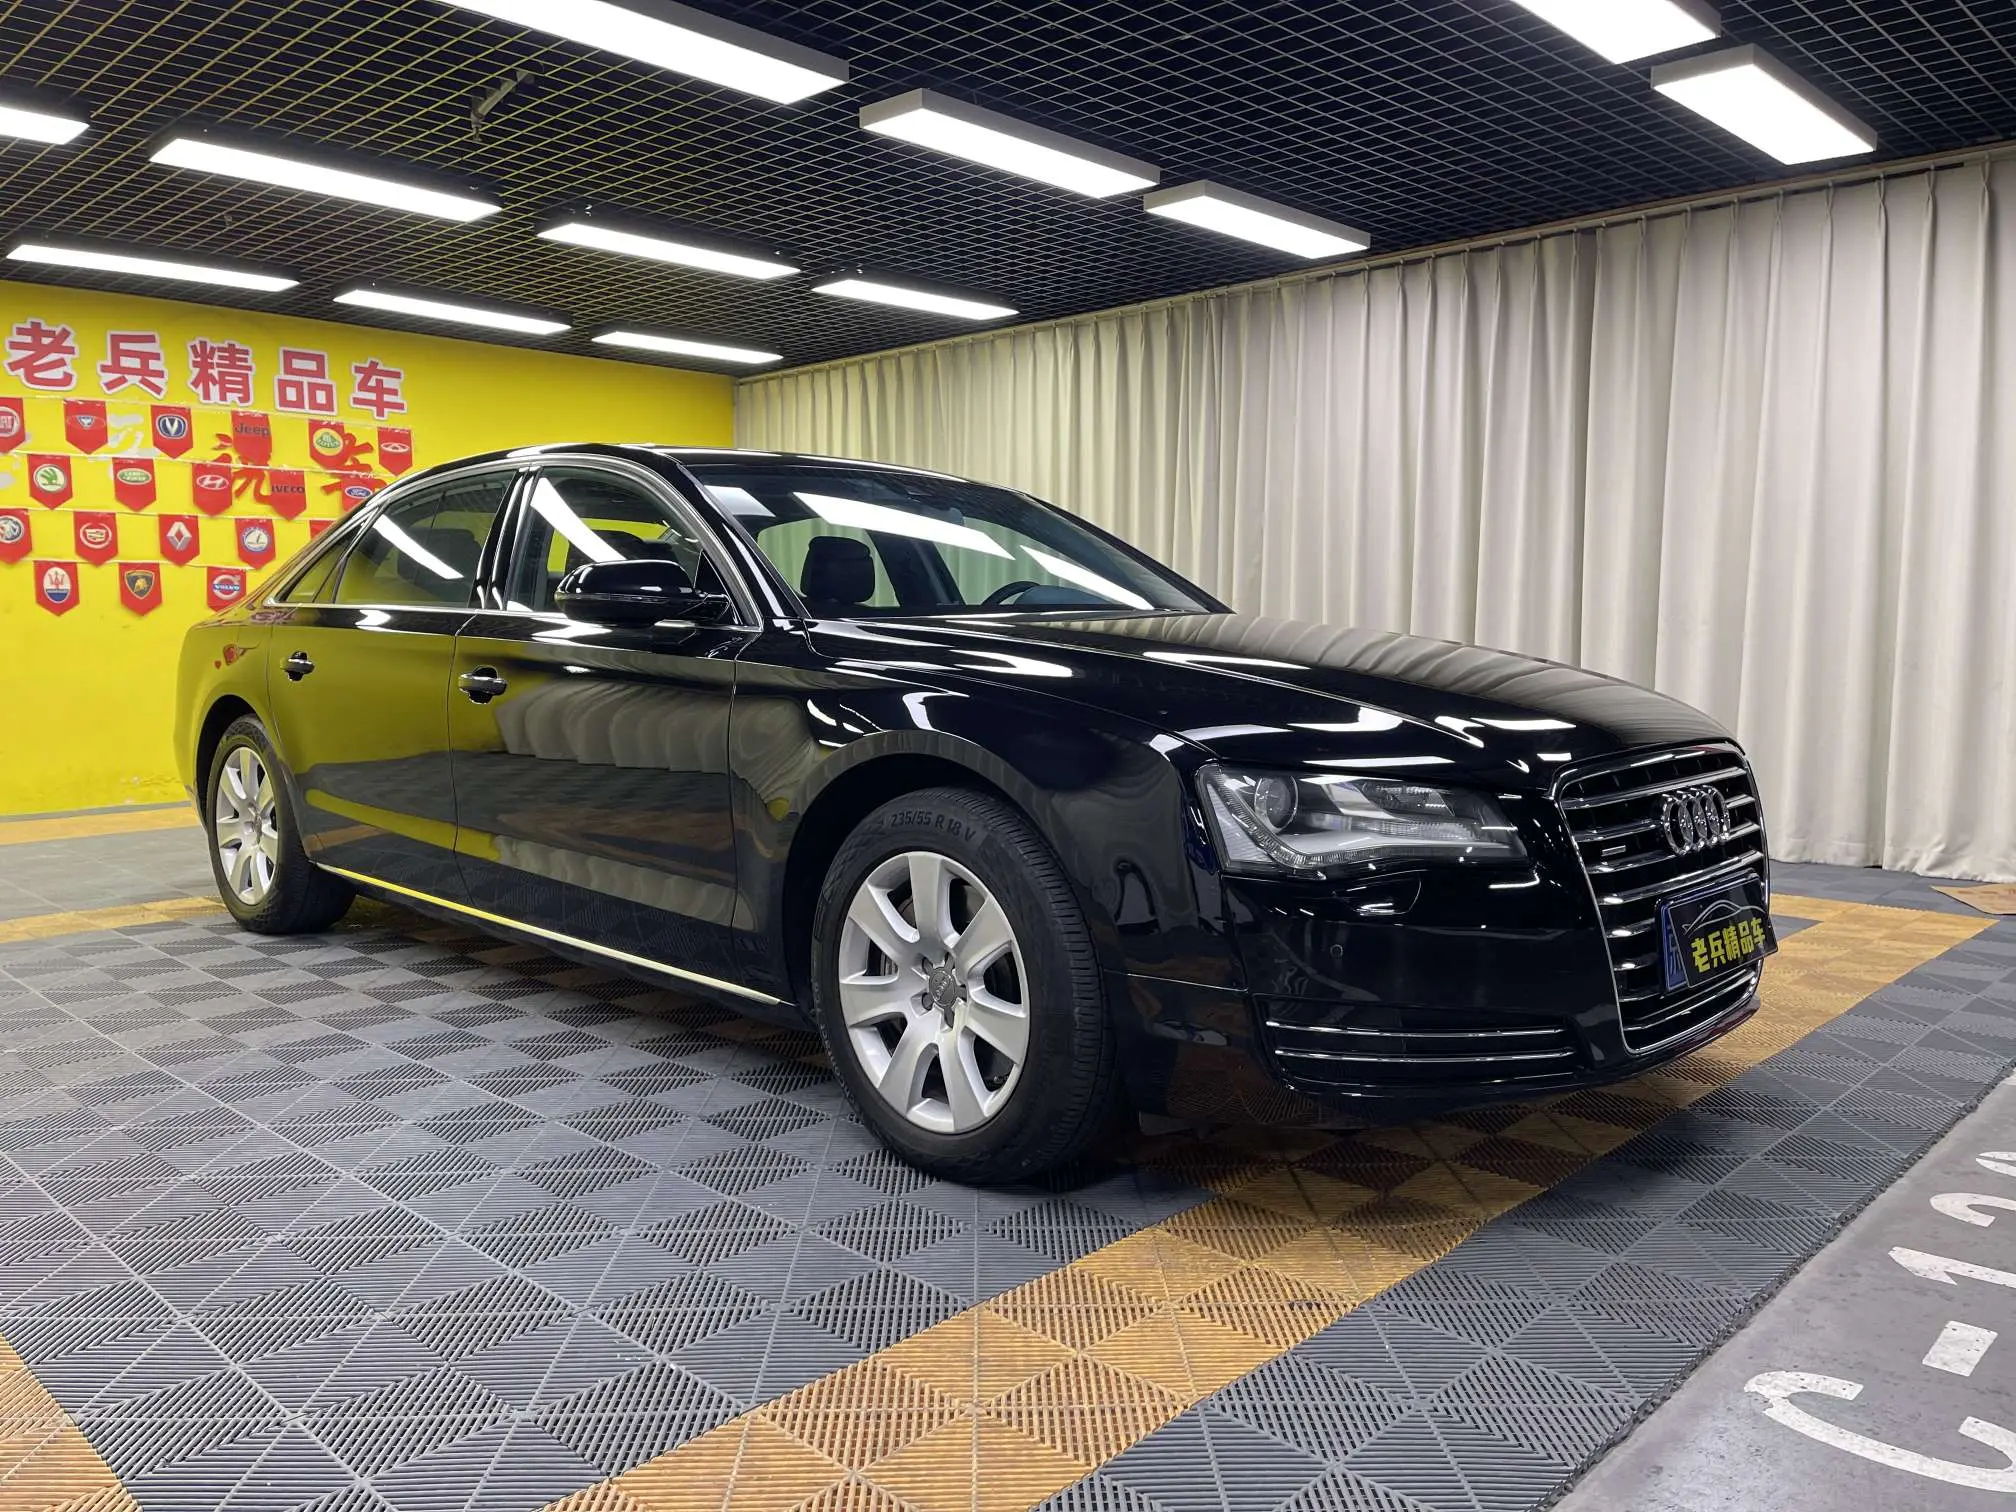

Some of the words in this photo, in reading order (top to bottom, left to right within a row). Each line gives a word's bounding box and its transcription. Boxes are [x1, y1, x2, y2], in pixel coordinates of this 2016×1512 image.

[4, 318, 406, 419] 老兵精品车
[235, 423, 269, 437] Jeep
[271, 485, 305, 493] IVECO
[891, 811, 933, 828] 235/55
[935, 814, 945, 829] R
[947, 818, 962, 836] 18
[1691, 917, 1765, 972] 老兵精品车
